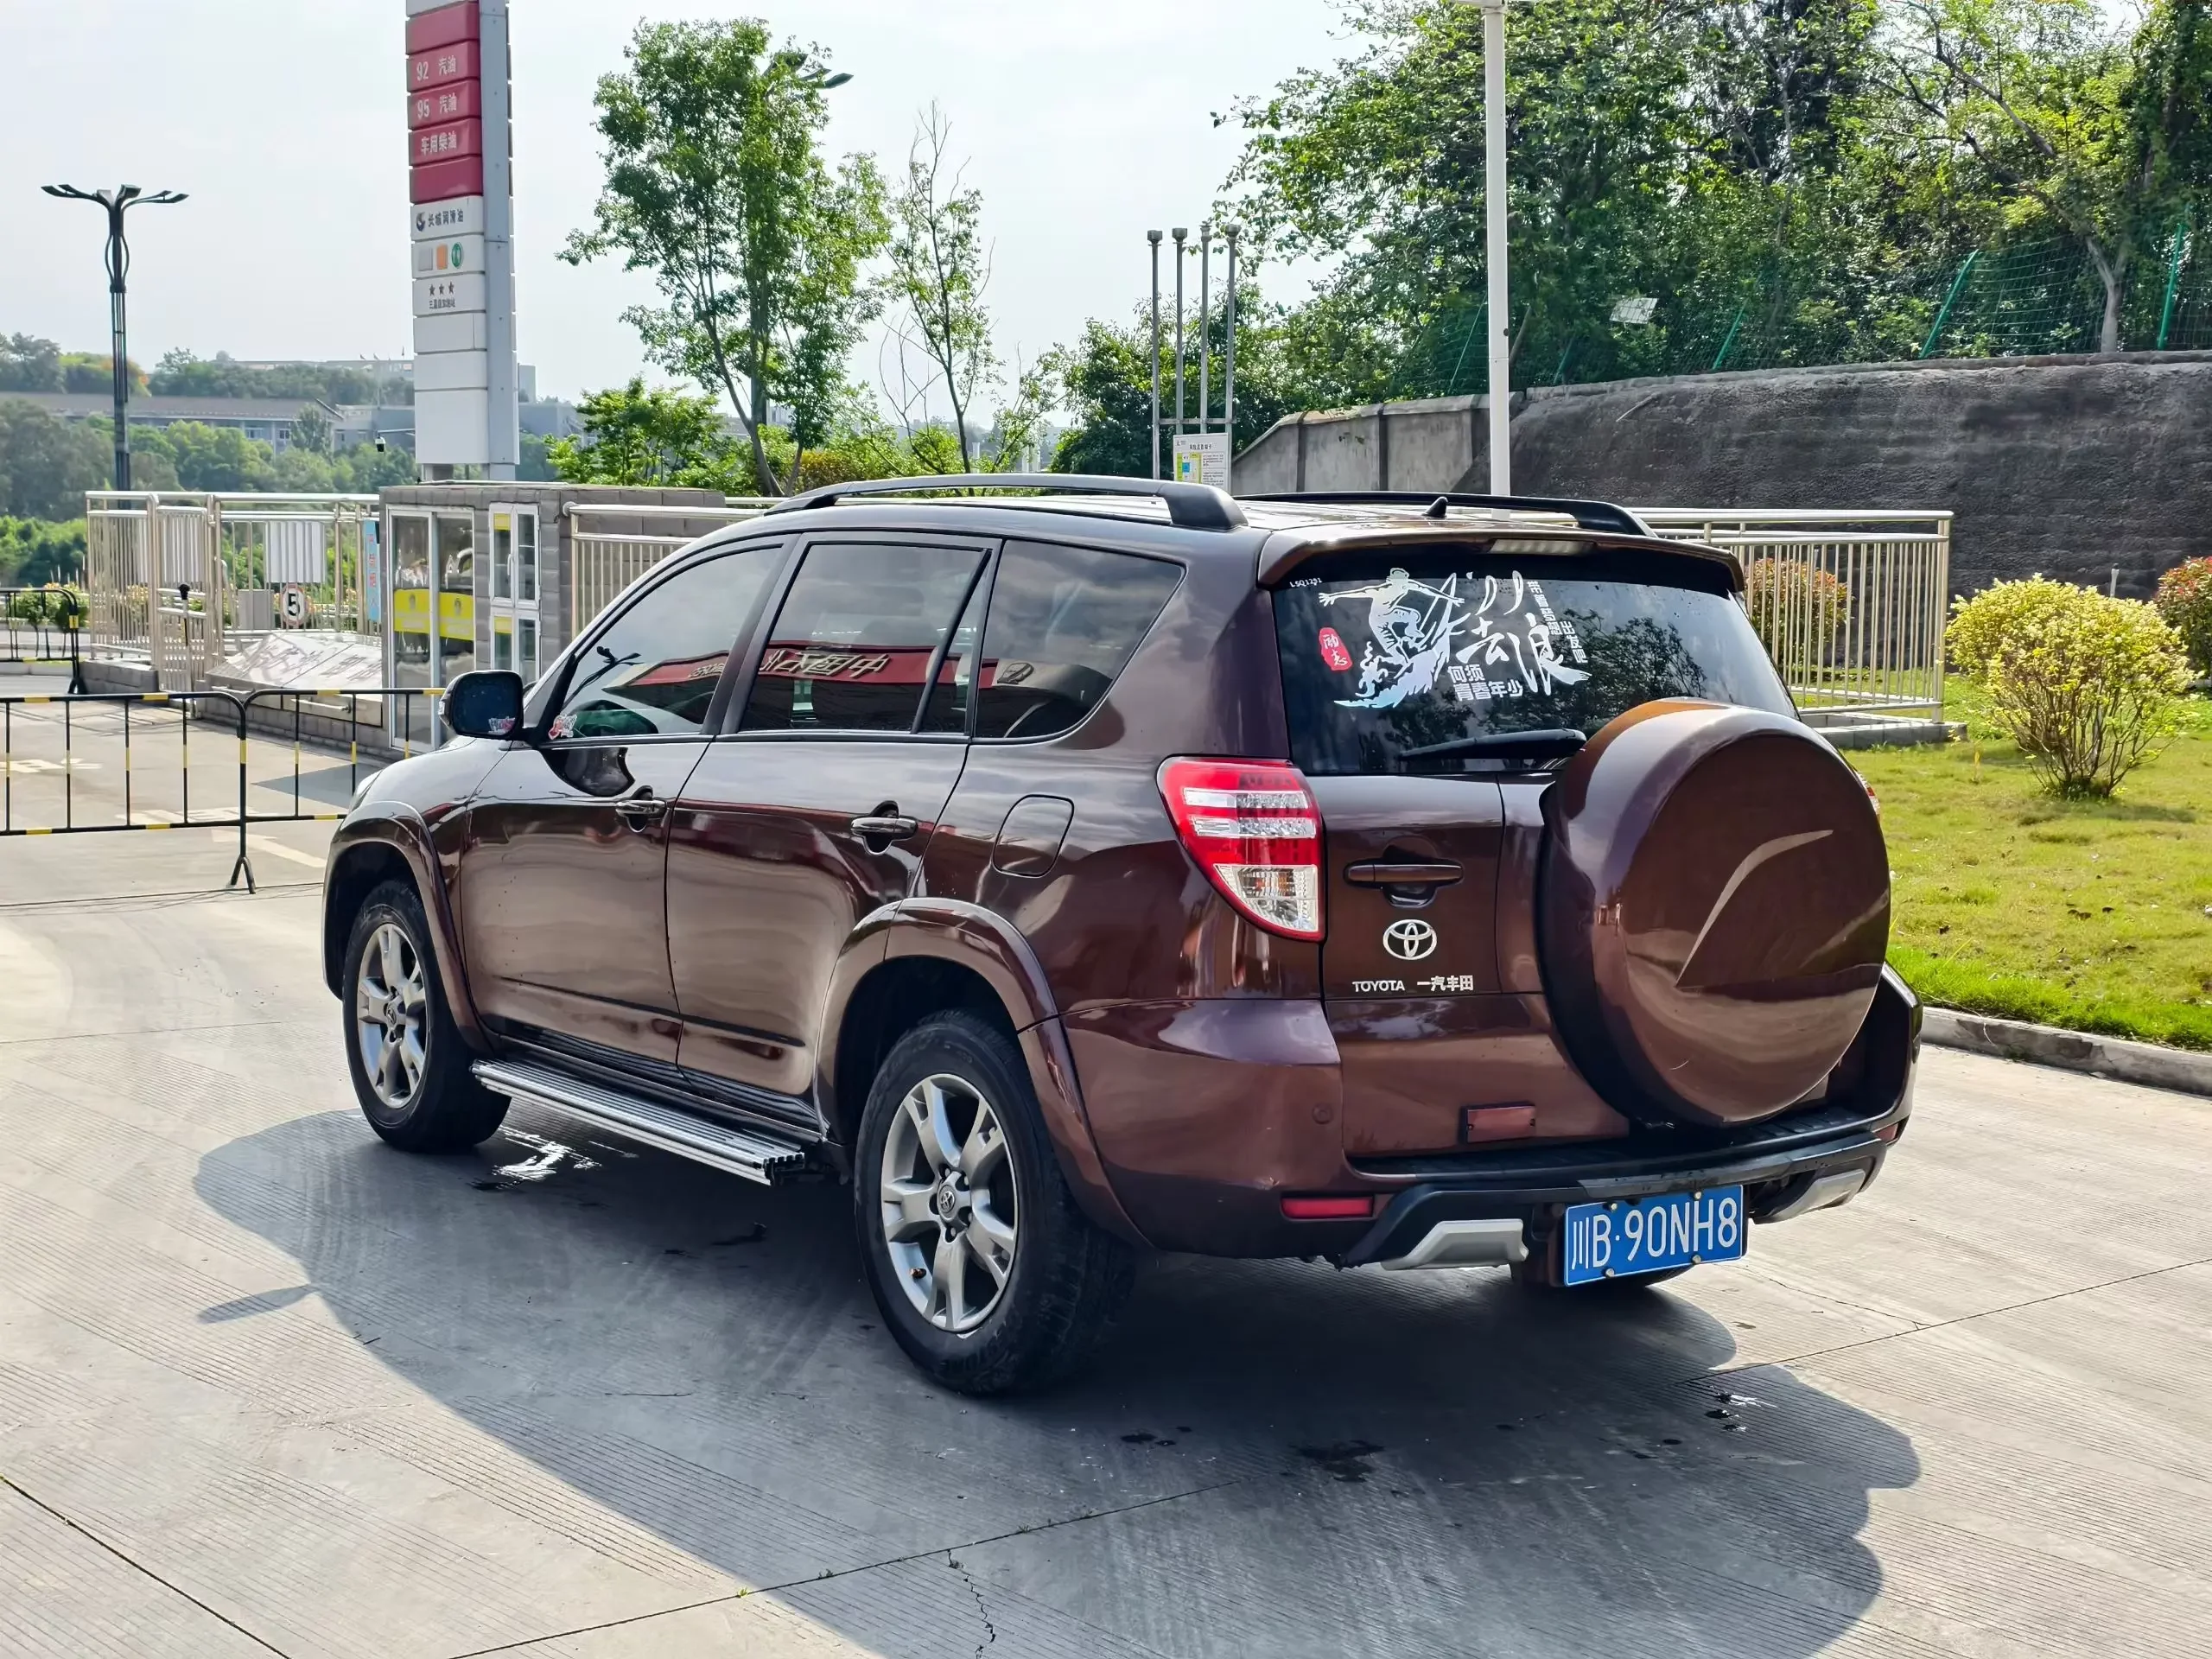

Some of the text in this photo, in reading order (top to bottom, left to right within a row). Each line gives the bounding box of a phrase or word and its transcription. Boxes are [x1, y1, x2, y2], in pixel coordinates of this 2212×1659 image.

[416, 55, 456, 80] 92 汽油
[417, 92, 457, 119] 95 汽油
[421, 130, 457, 156] 车用柴油
[288, 594, 300, 616] 5
[1560, 621, 1588, 663] 出发吧
[1447, 664, 1485, 683] 何须
[1453, 679, 1523, 702] 青春年少
[1352, 976, 1473, 992] TOYOTA 一汽丰田
